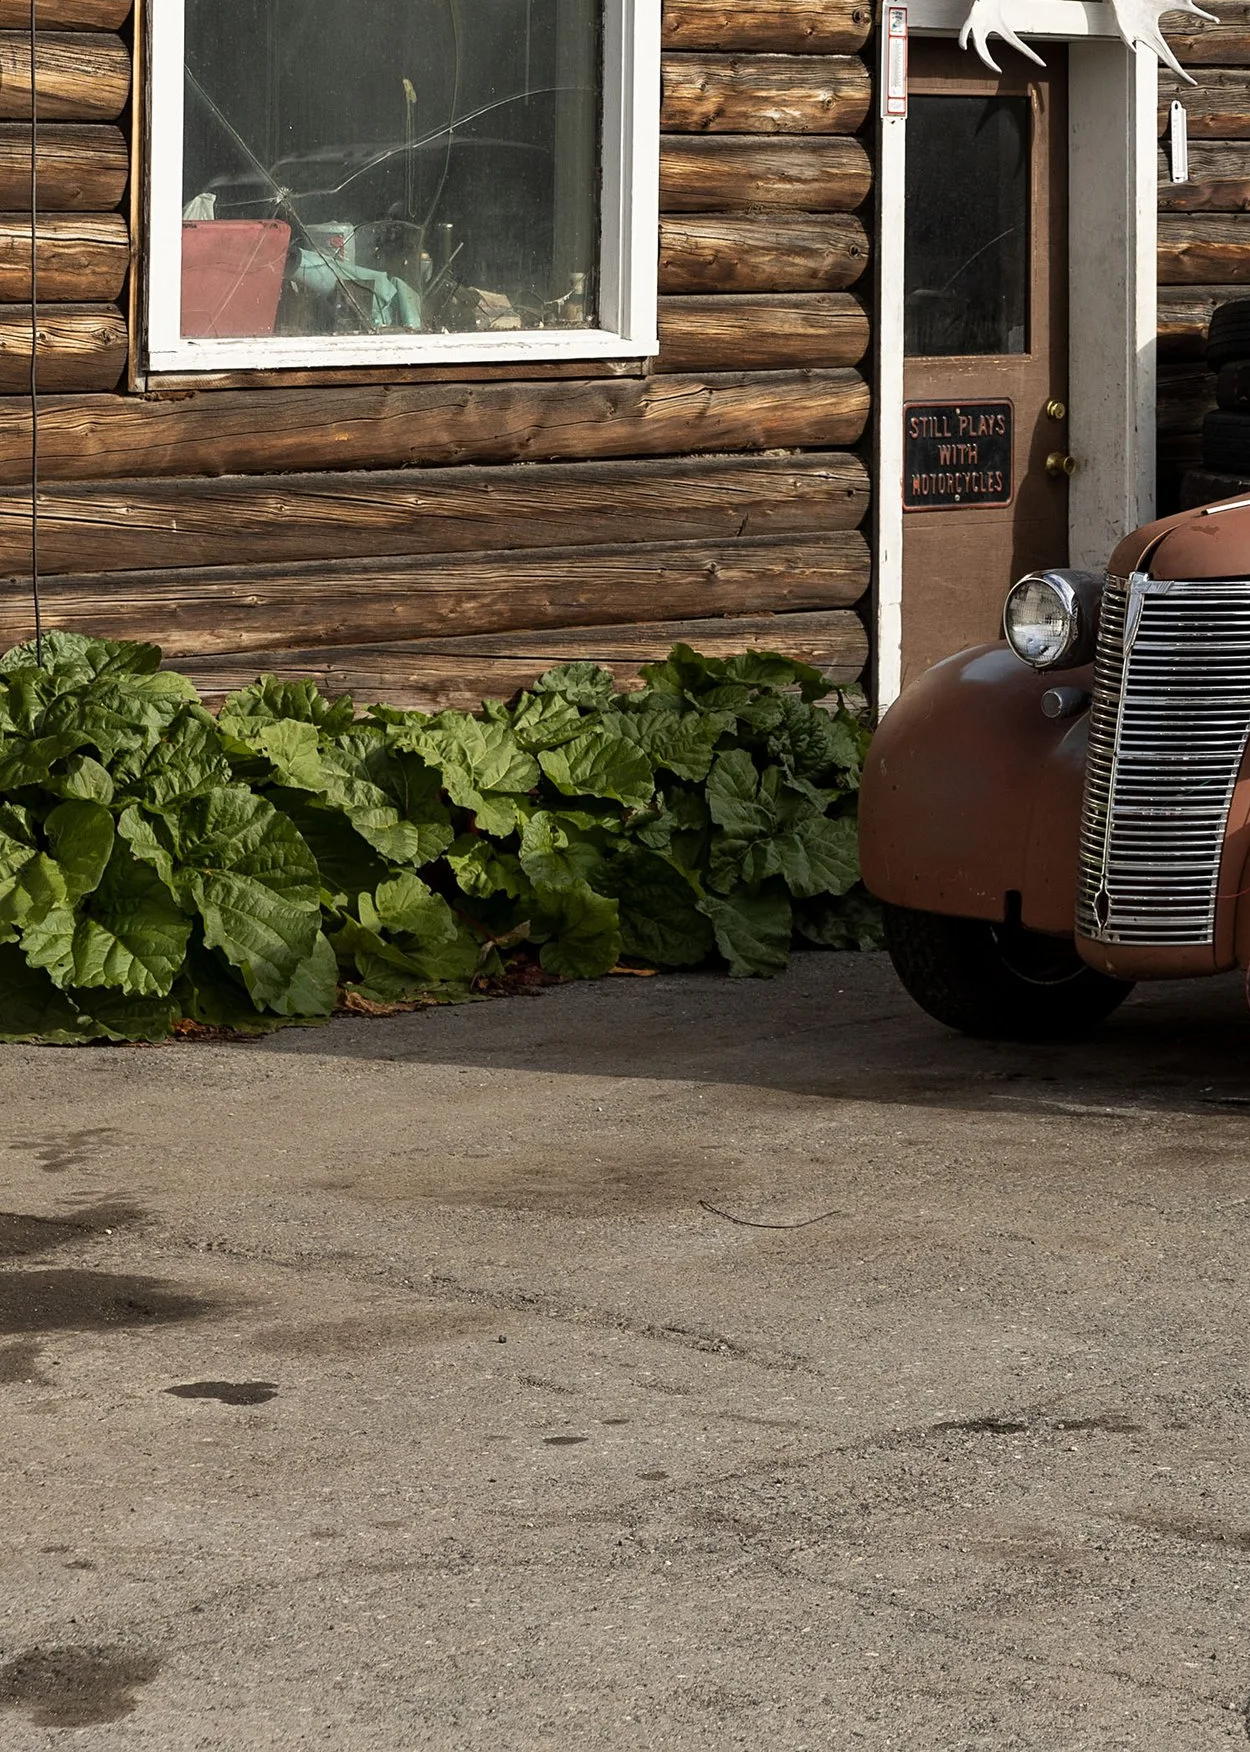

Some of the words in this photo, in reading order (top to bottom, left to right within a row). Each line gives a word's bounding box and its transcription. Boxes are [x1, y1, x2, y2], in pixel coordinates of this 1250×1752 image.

[909, 416, 952, 439] STILL
[958, 414, 1006, 436] PLAYS
[938, 443, 978, 465] WITH
[911, 471, 1003, 496] MOTORCYCLES
